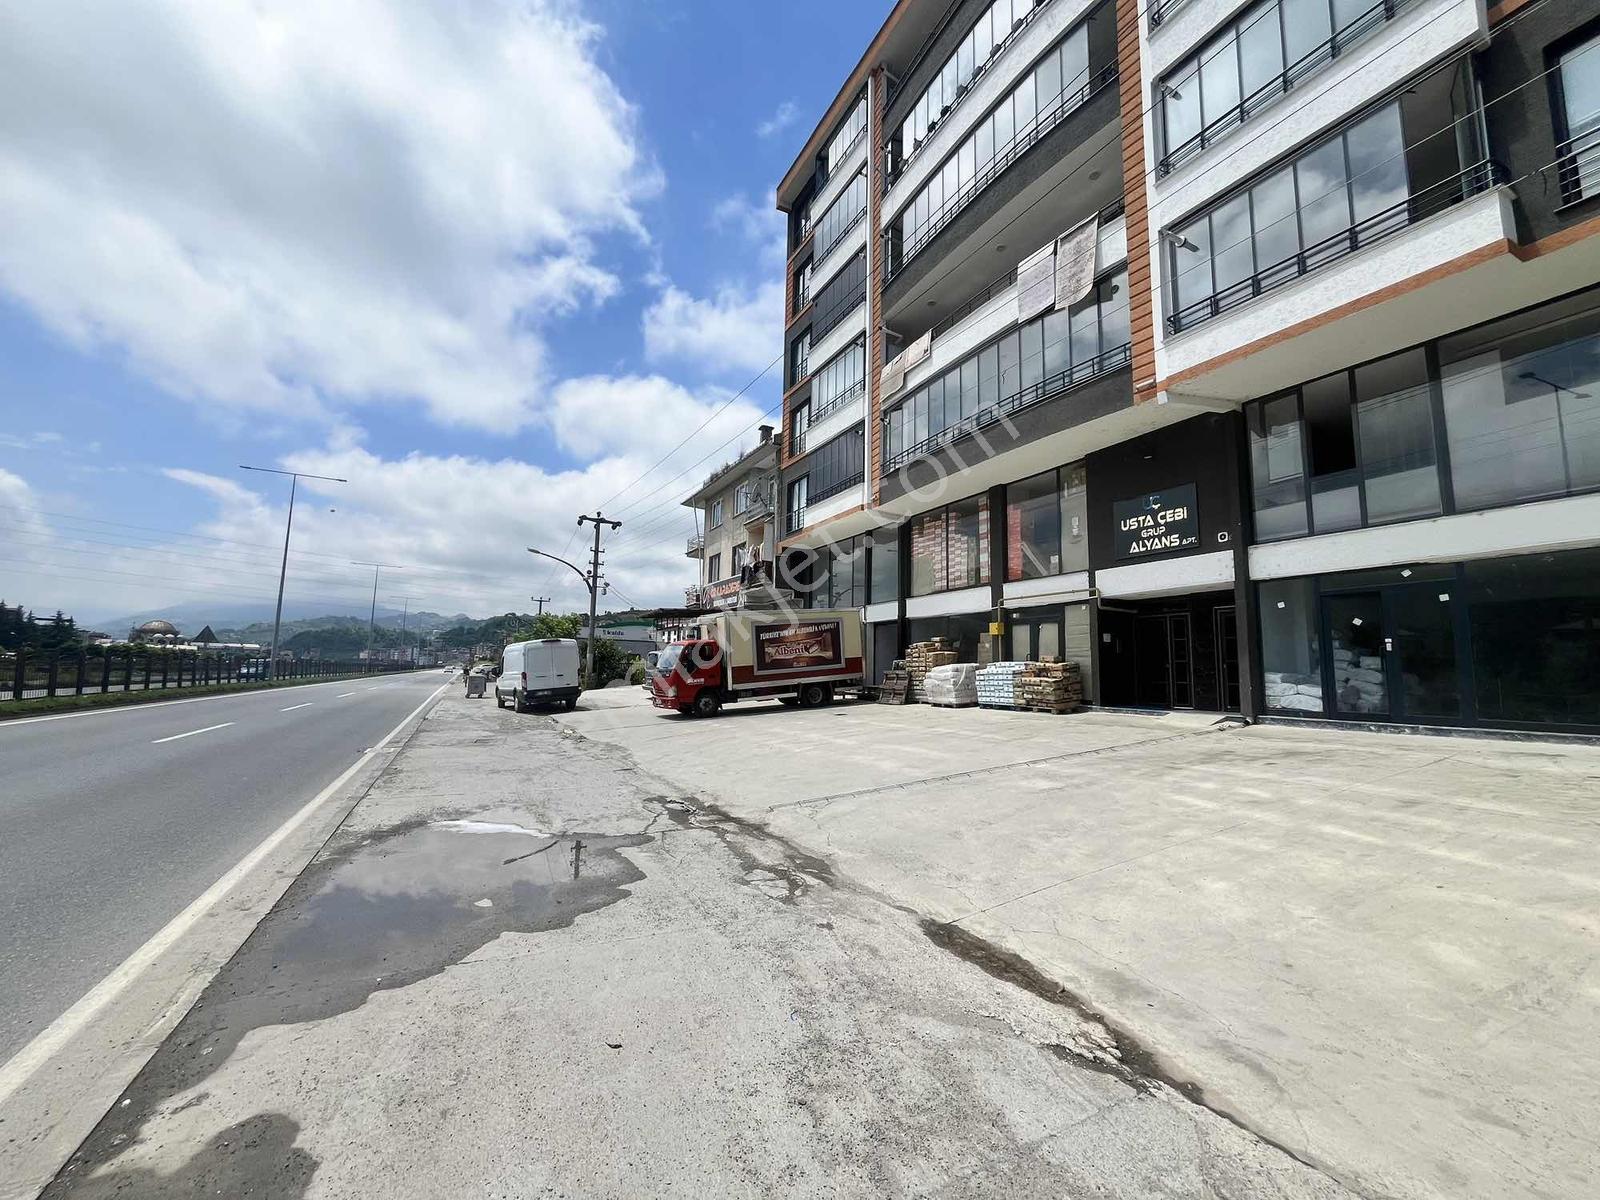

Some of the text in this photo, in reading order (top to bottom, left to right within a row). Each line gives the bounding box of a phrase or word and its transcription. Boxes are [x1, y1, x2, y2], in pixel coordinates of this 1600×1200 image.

[1121, 514, 1154, 531] USTA
[1141, 526, 1166, 538] GRUP
[1129, 534, 1180, 553] ALYANS
